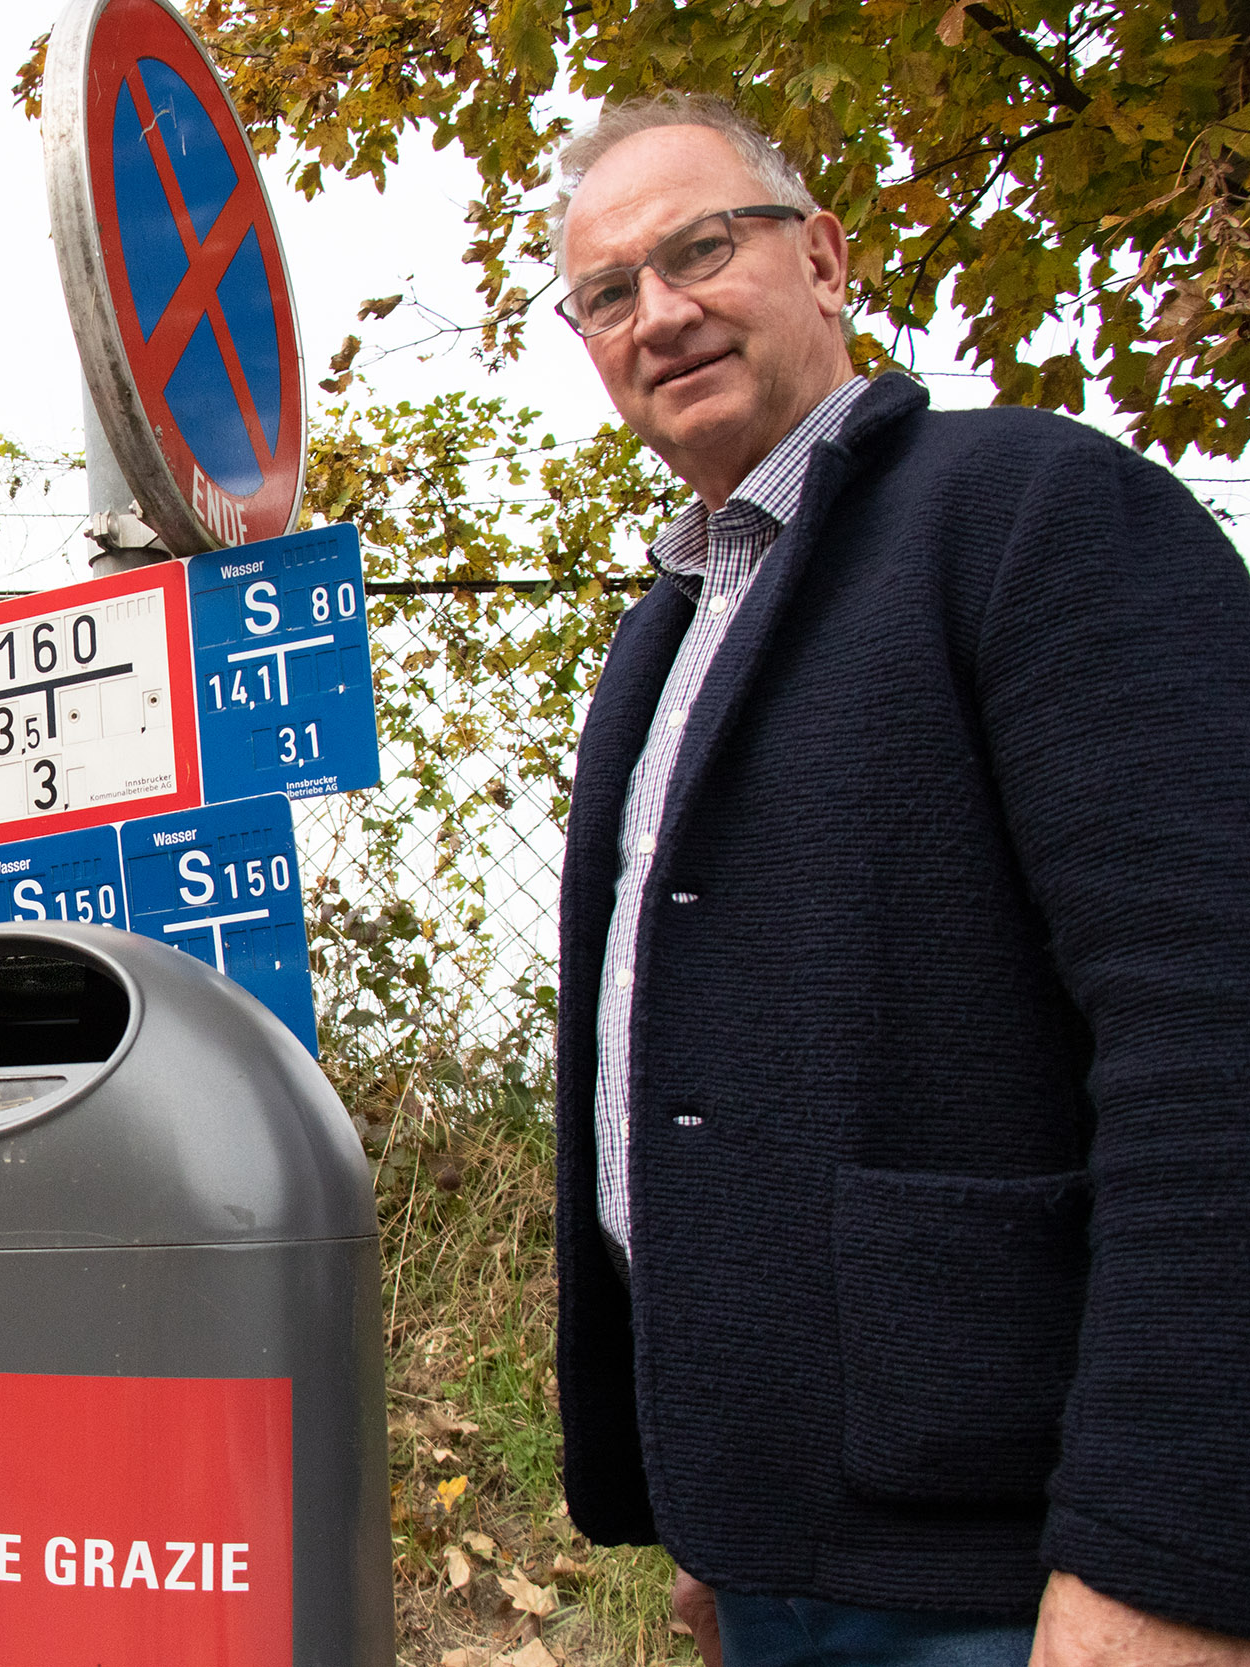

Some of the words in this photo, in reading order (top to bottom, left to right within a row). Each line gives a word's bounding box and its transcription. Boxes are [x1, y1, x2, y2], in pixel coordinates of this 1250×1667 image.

[192, 463, 248, 548] ENDE
[220, 559, 265, 580] Wasser
[244, 581, 280, 635] S
[312, 582, 357, 622] 80
[209, 664, 272, 711] 14,1
[279, 722, 320, 768] 3,1
[125, 773, 172, 788] Innsbrucker
[286, 775, 338, 790] Innsbrucker
[325, 782, 338, 793] AG
[90, 784, 159, 802] Kommunalbetriebe
[160, 781, 173, 790] AG
[153, 829, 197, 847] Wasser
[44, 1536, 250, 1592] GRAZIE
